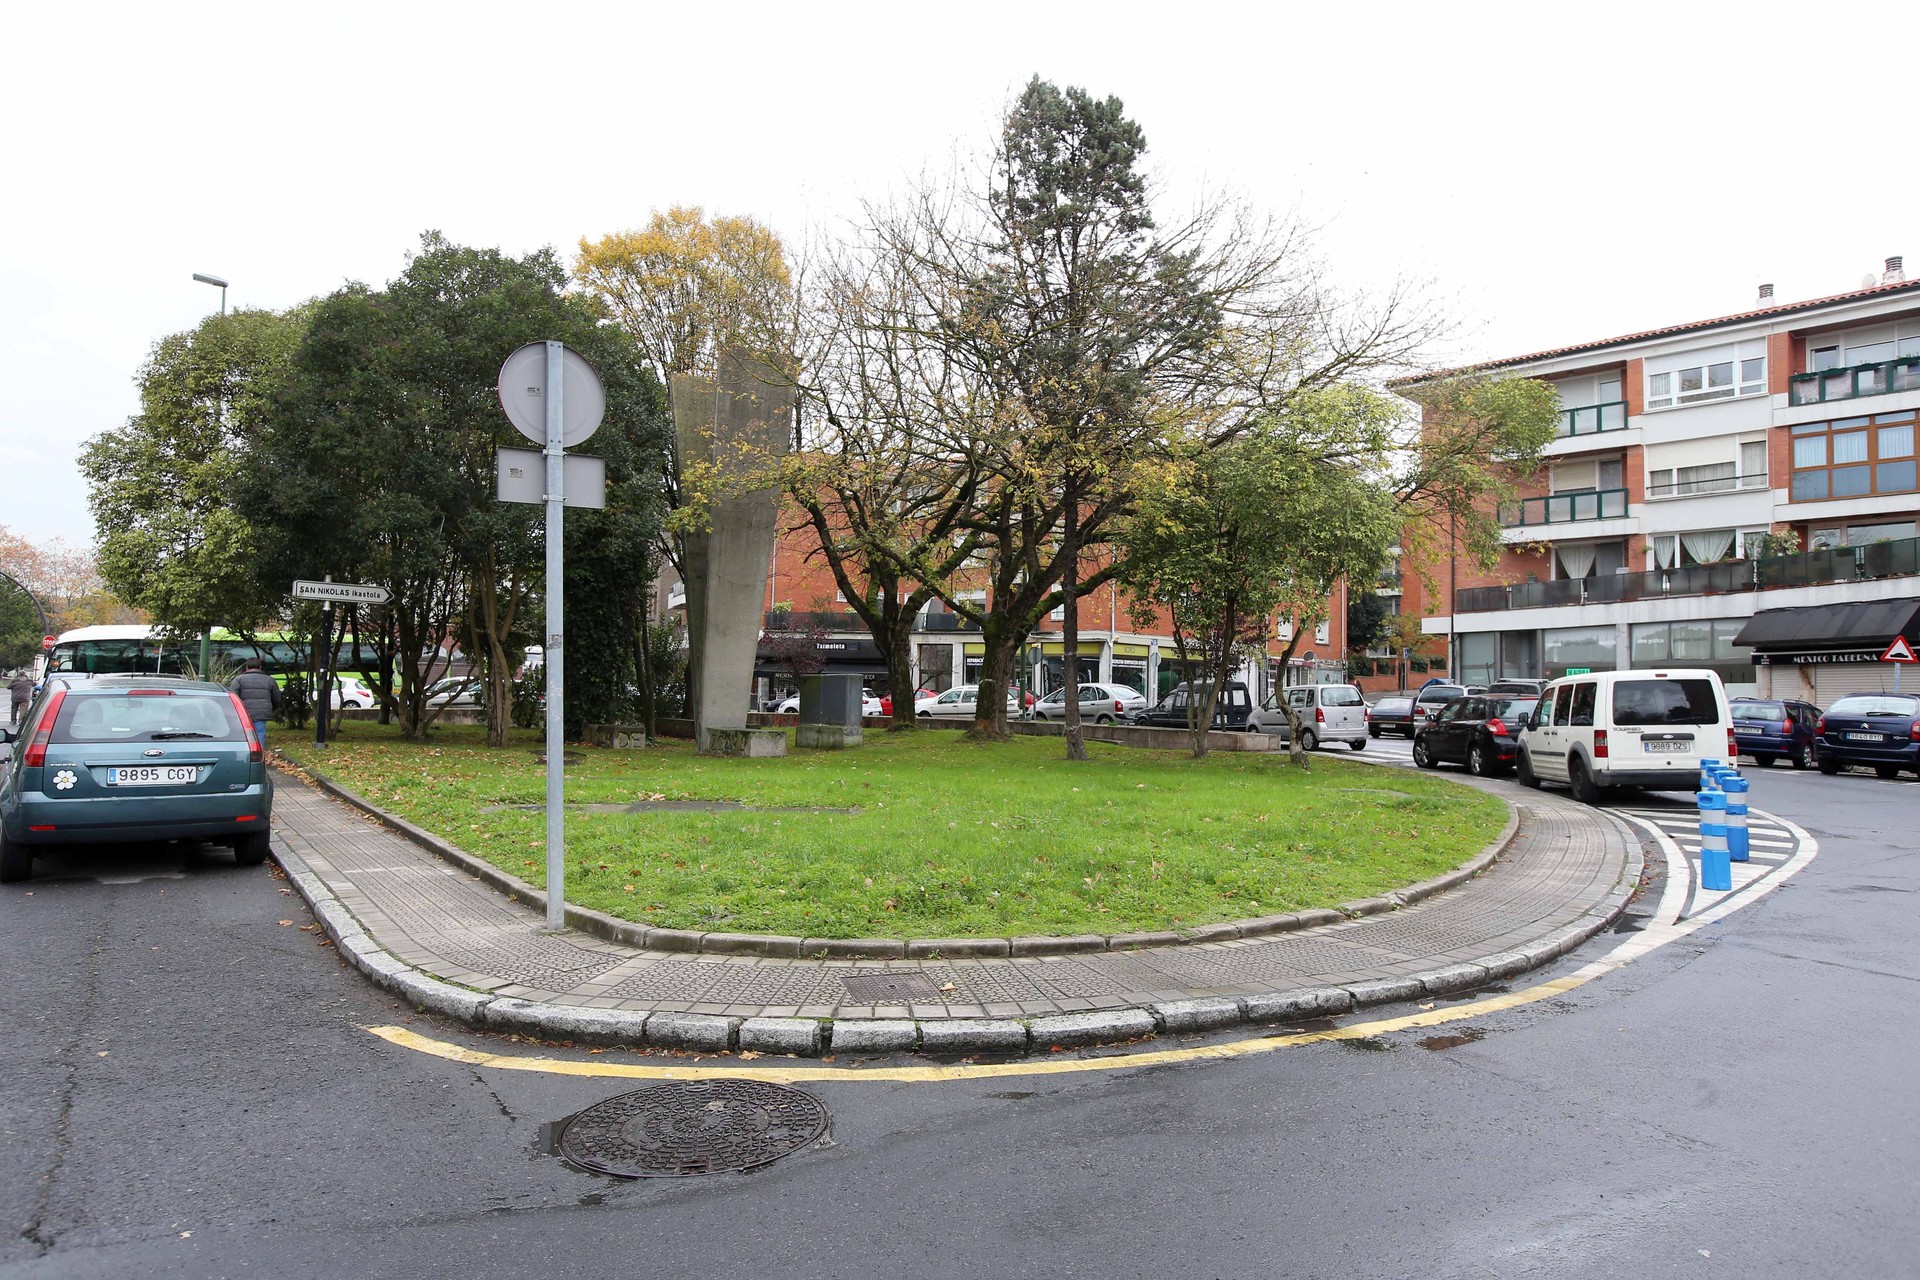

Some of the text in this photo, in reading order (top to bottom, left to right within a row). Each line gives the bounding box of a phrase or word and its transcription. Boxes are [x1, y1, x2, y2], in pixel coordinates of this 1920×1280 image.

[300, 586, 380, 599] SAN NIKOLAS ikastola
[1793, 653, 1878, 663] MEXICO TABERNA
[119, 768, 194, 781] 9895 CGY
